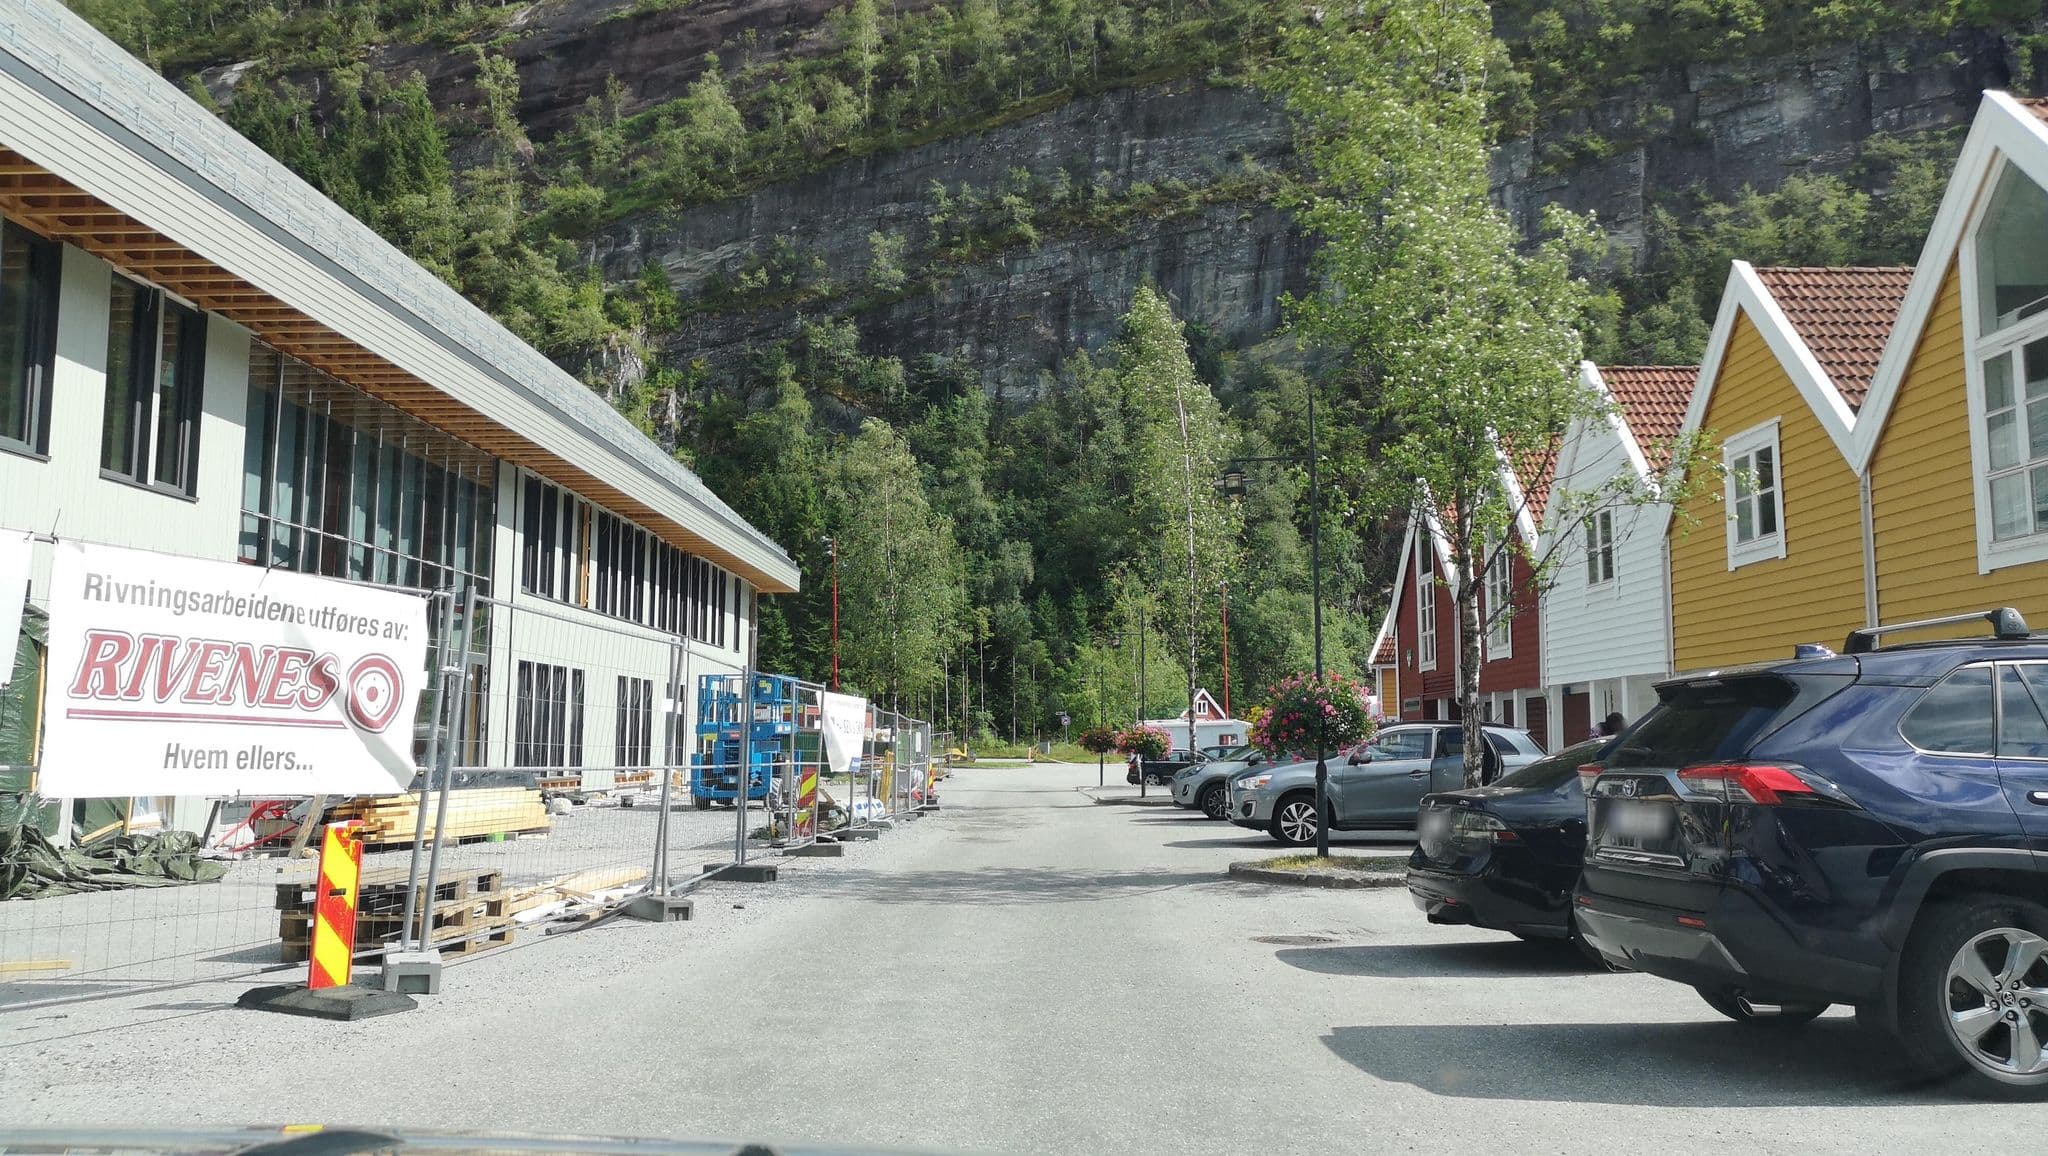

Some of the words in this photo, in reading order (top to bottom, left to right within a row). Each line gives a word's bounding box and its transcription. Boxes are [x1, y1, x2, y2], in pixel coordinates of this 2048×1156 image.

[84, 572, 305, 624] Rivningsarbeidene
[309, 606, 379, 636] utføres
[383, 620, 408, 641] av:
[67, 630, 340, 711] RIVENES
[164, 743, 228, 769] Hvem
[236, 745, 313, 770] ellers...
